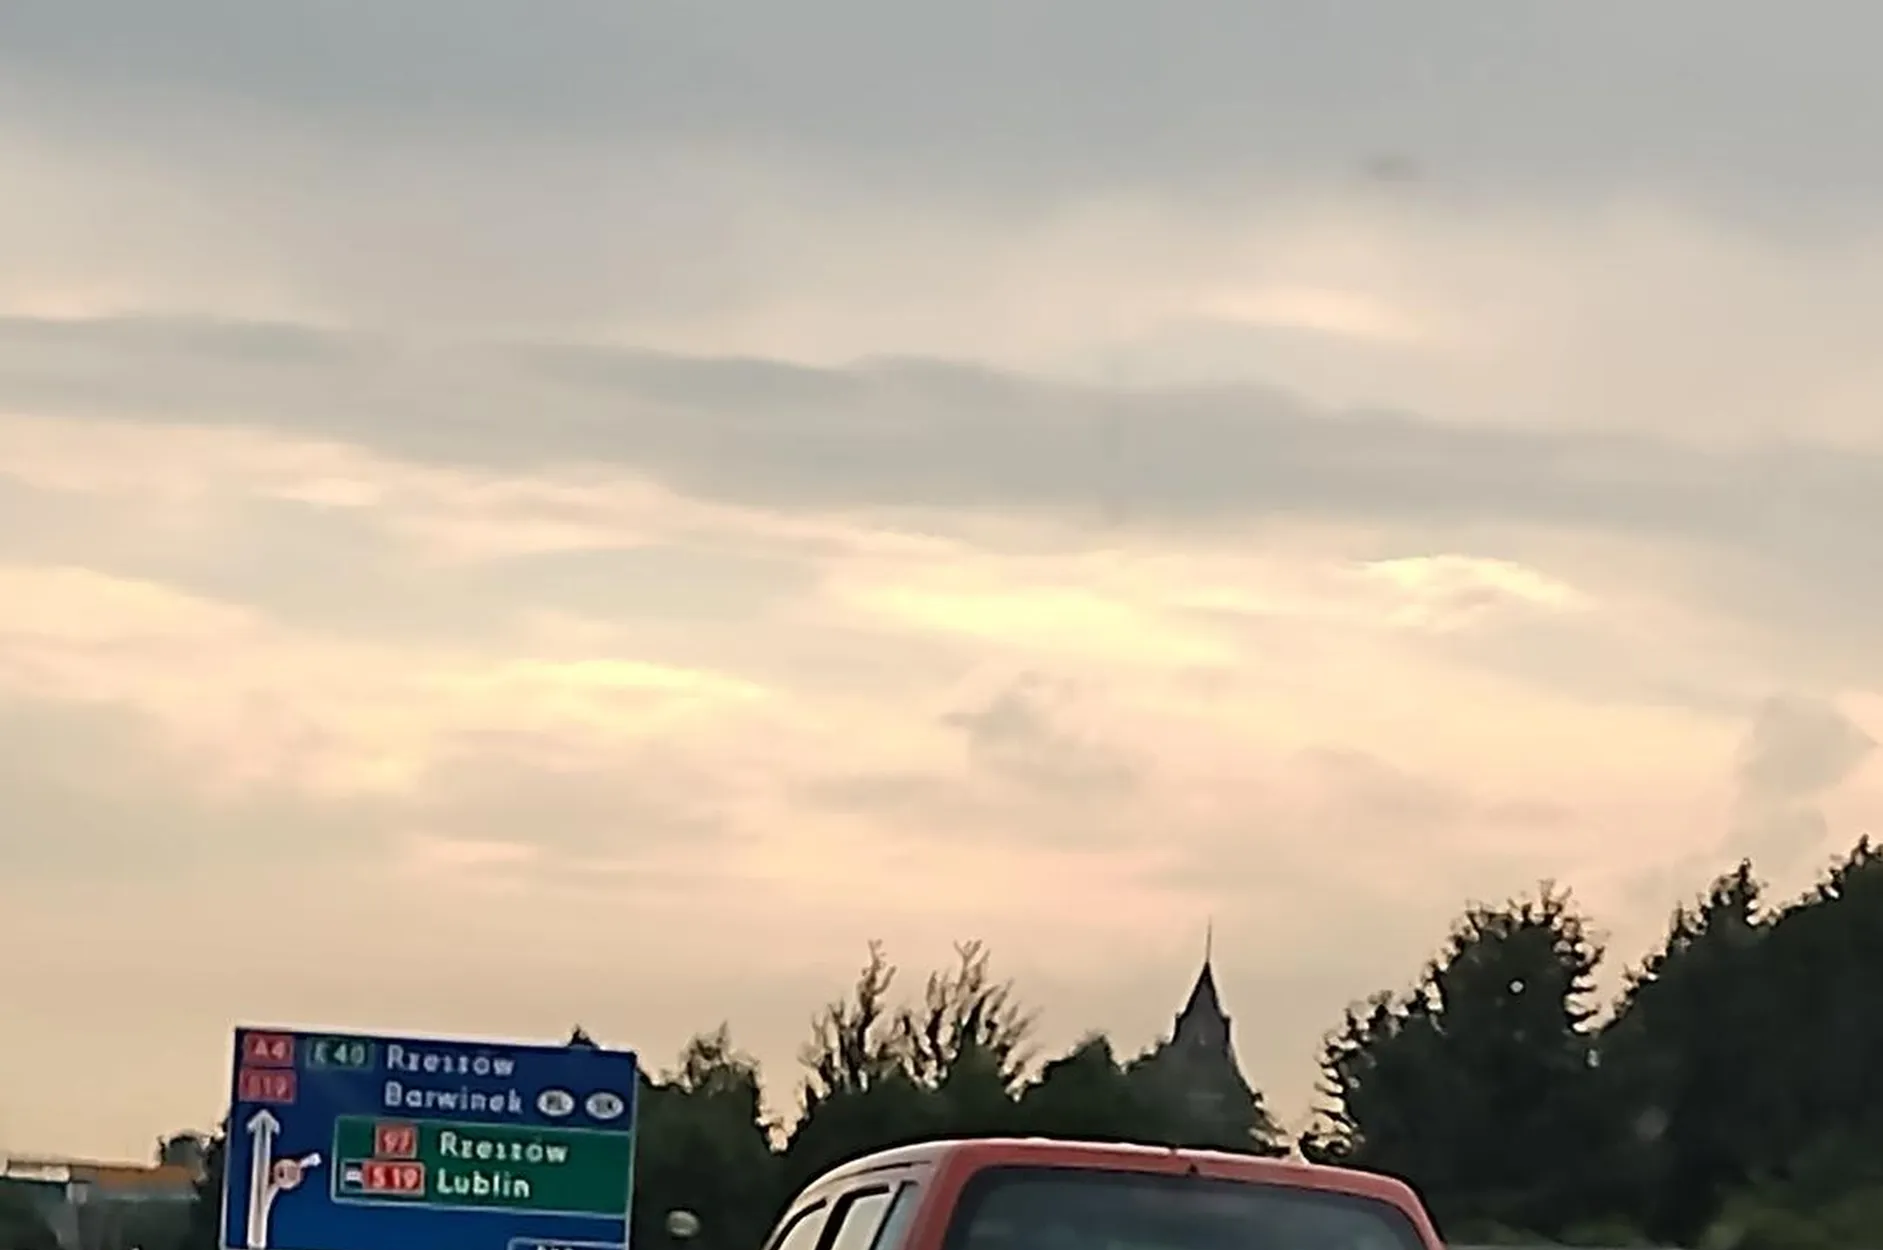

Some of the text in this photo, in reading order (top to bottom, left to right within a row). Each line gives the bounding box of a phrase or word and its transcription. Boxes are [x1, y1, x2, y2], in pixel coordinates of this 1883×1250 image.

[254, 1038, 286, 1060] A4
[384, 1081, 523, 1114] Barwinek
[371, 1166, 419, 1188] S19
[437, 1168, 530, 1198] Lublin
